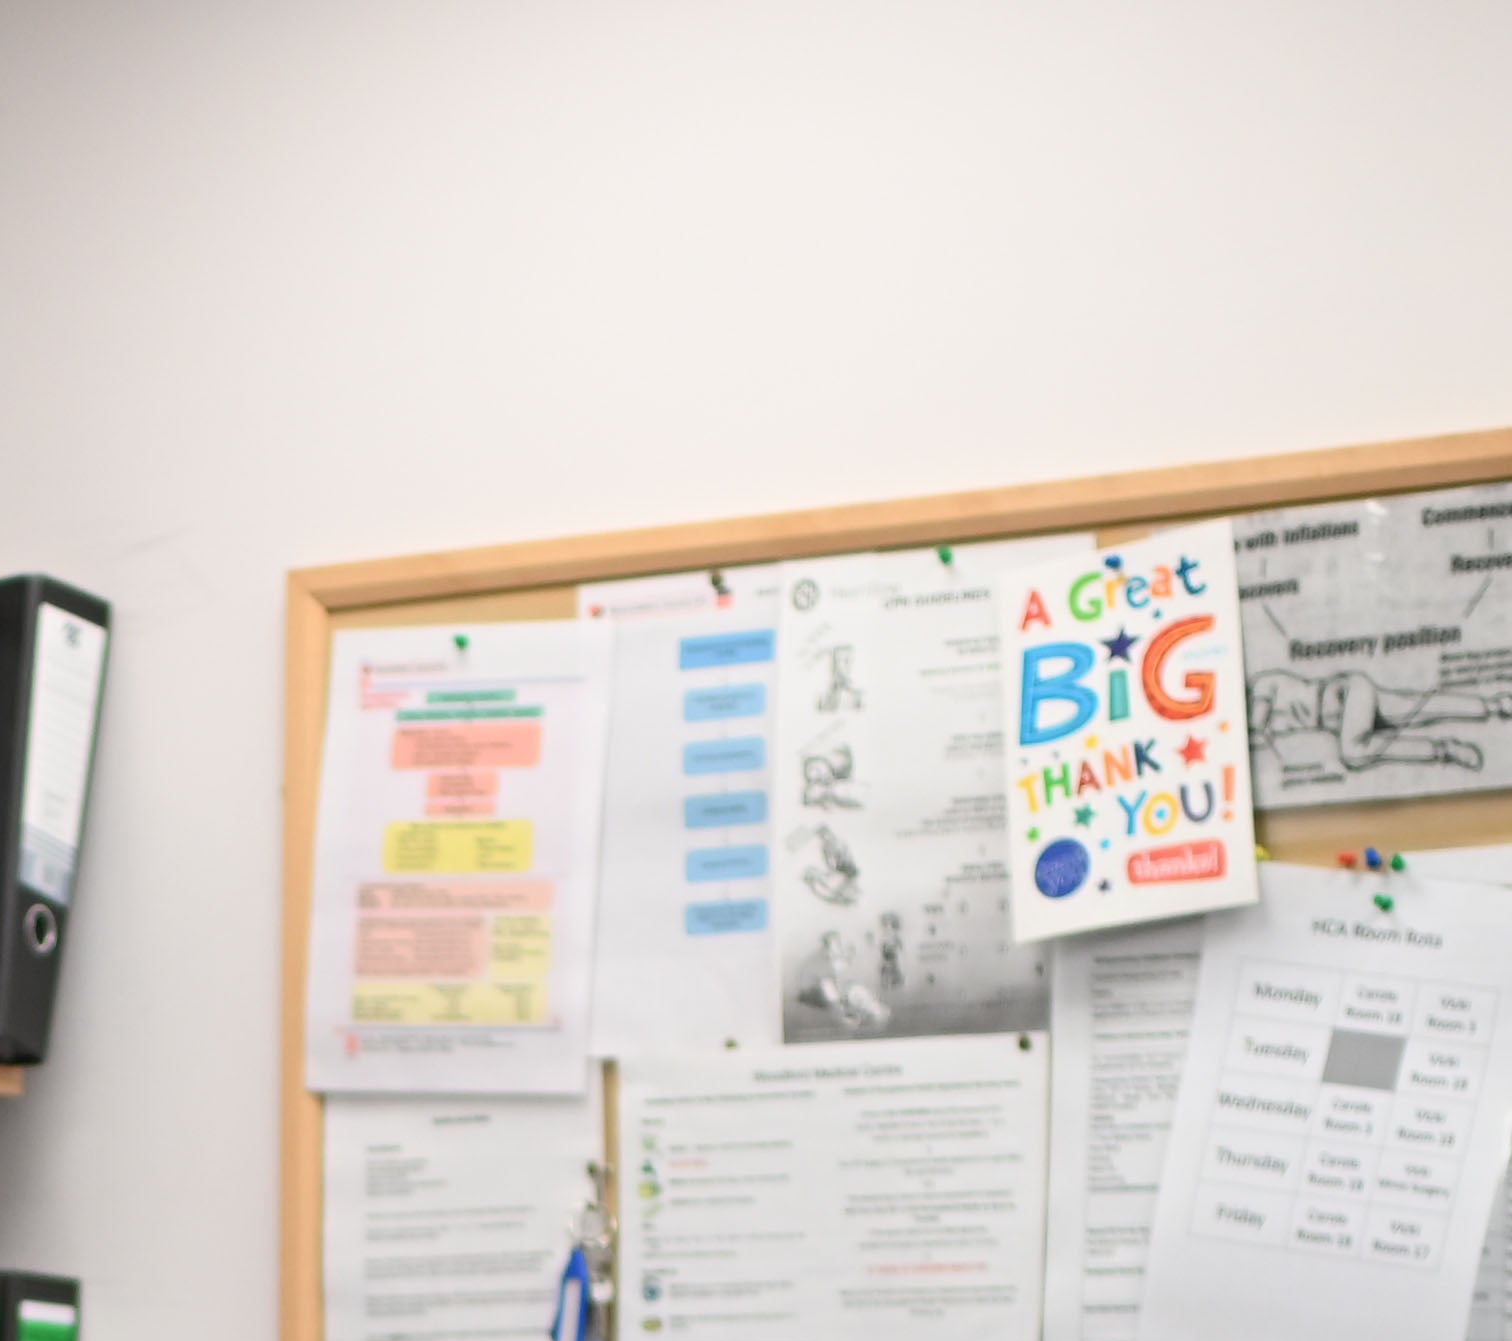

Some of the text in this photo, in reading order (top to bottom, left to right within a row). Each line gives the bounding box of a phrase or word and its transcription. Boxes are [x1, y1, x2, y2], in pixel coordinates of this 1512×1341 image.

[1019, 554, 1207, 633] A Great
[1289, 626, 1461, 661] Recovery position
[1018, 738, 1163, 813] THANK
[1118, 764, 1236, 836] YOU!
[1254, 981, 1323, 1010] Monday
[1244, 1036, 1310, 1065] Tuesday
[1217, 1090, 1311, 1120] Wednesday
[1216, 1146, 1290, 1175] Thursday
[1216, 1203, 1266, 1229] Friday
